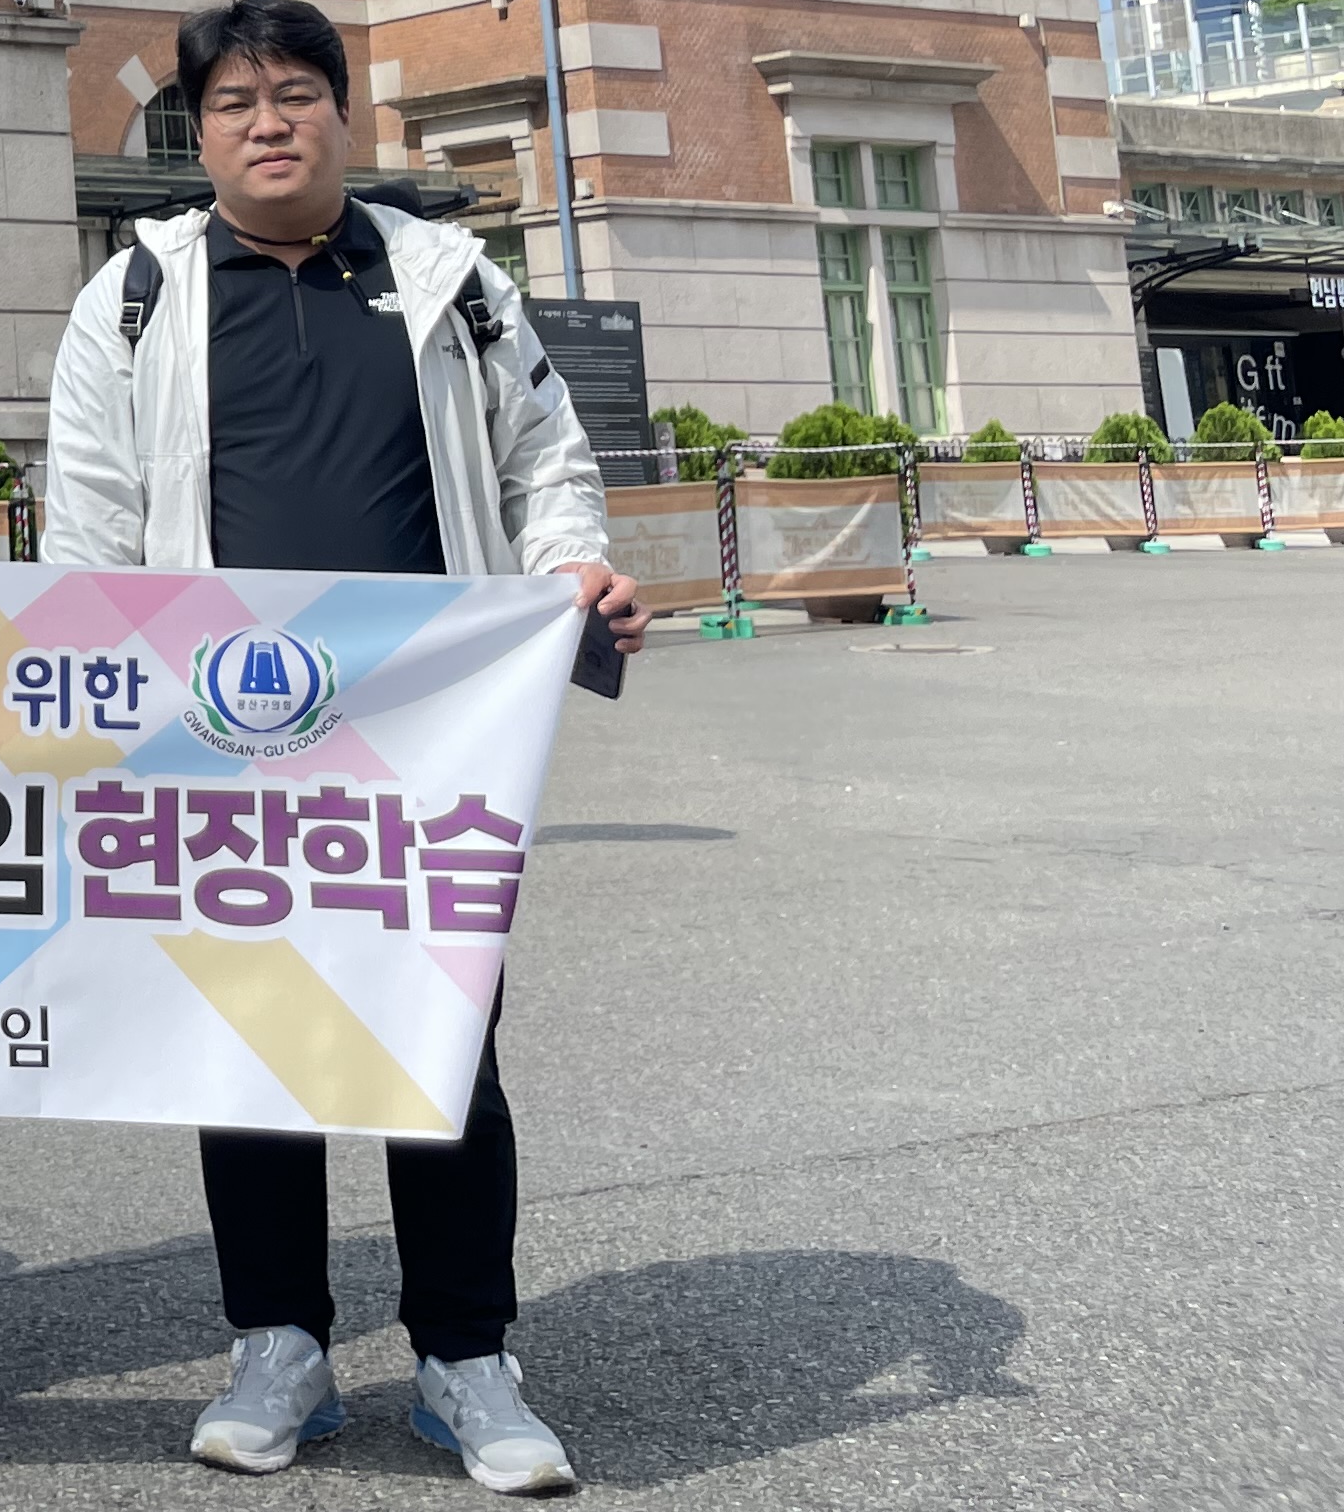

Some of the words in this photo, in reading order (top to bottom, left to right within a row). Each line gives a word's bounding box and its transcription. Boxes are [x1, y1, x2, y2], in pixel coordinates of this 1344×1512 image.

[11, 654, 149, 731] 위한
[237, 699, 292, 711] 광산구의회
[183, 709, 285, 758] GWANGSAN-GU
[287, 709, 344, 753] COUNCIL
[75, 780, 526, 933] 현장학습
